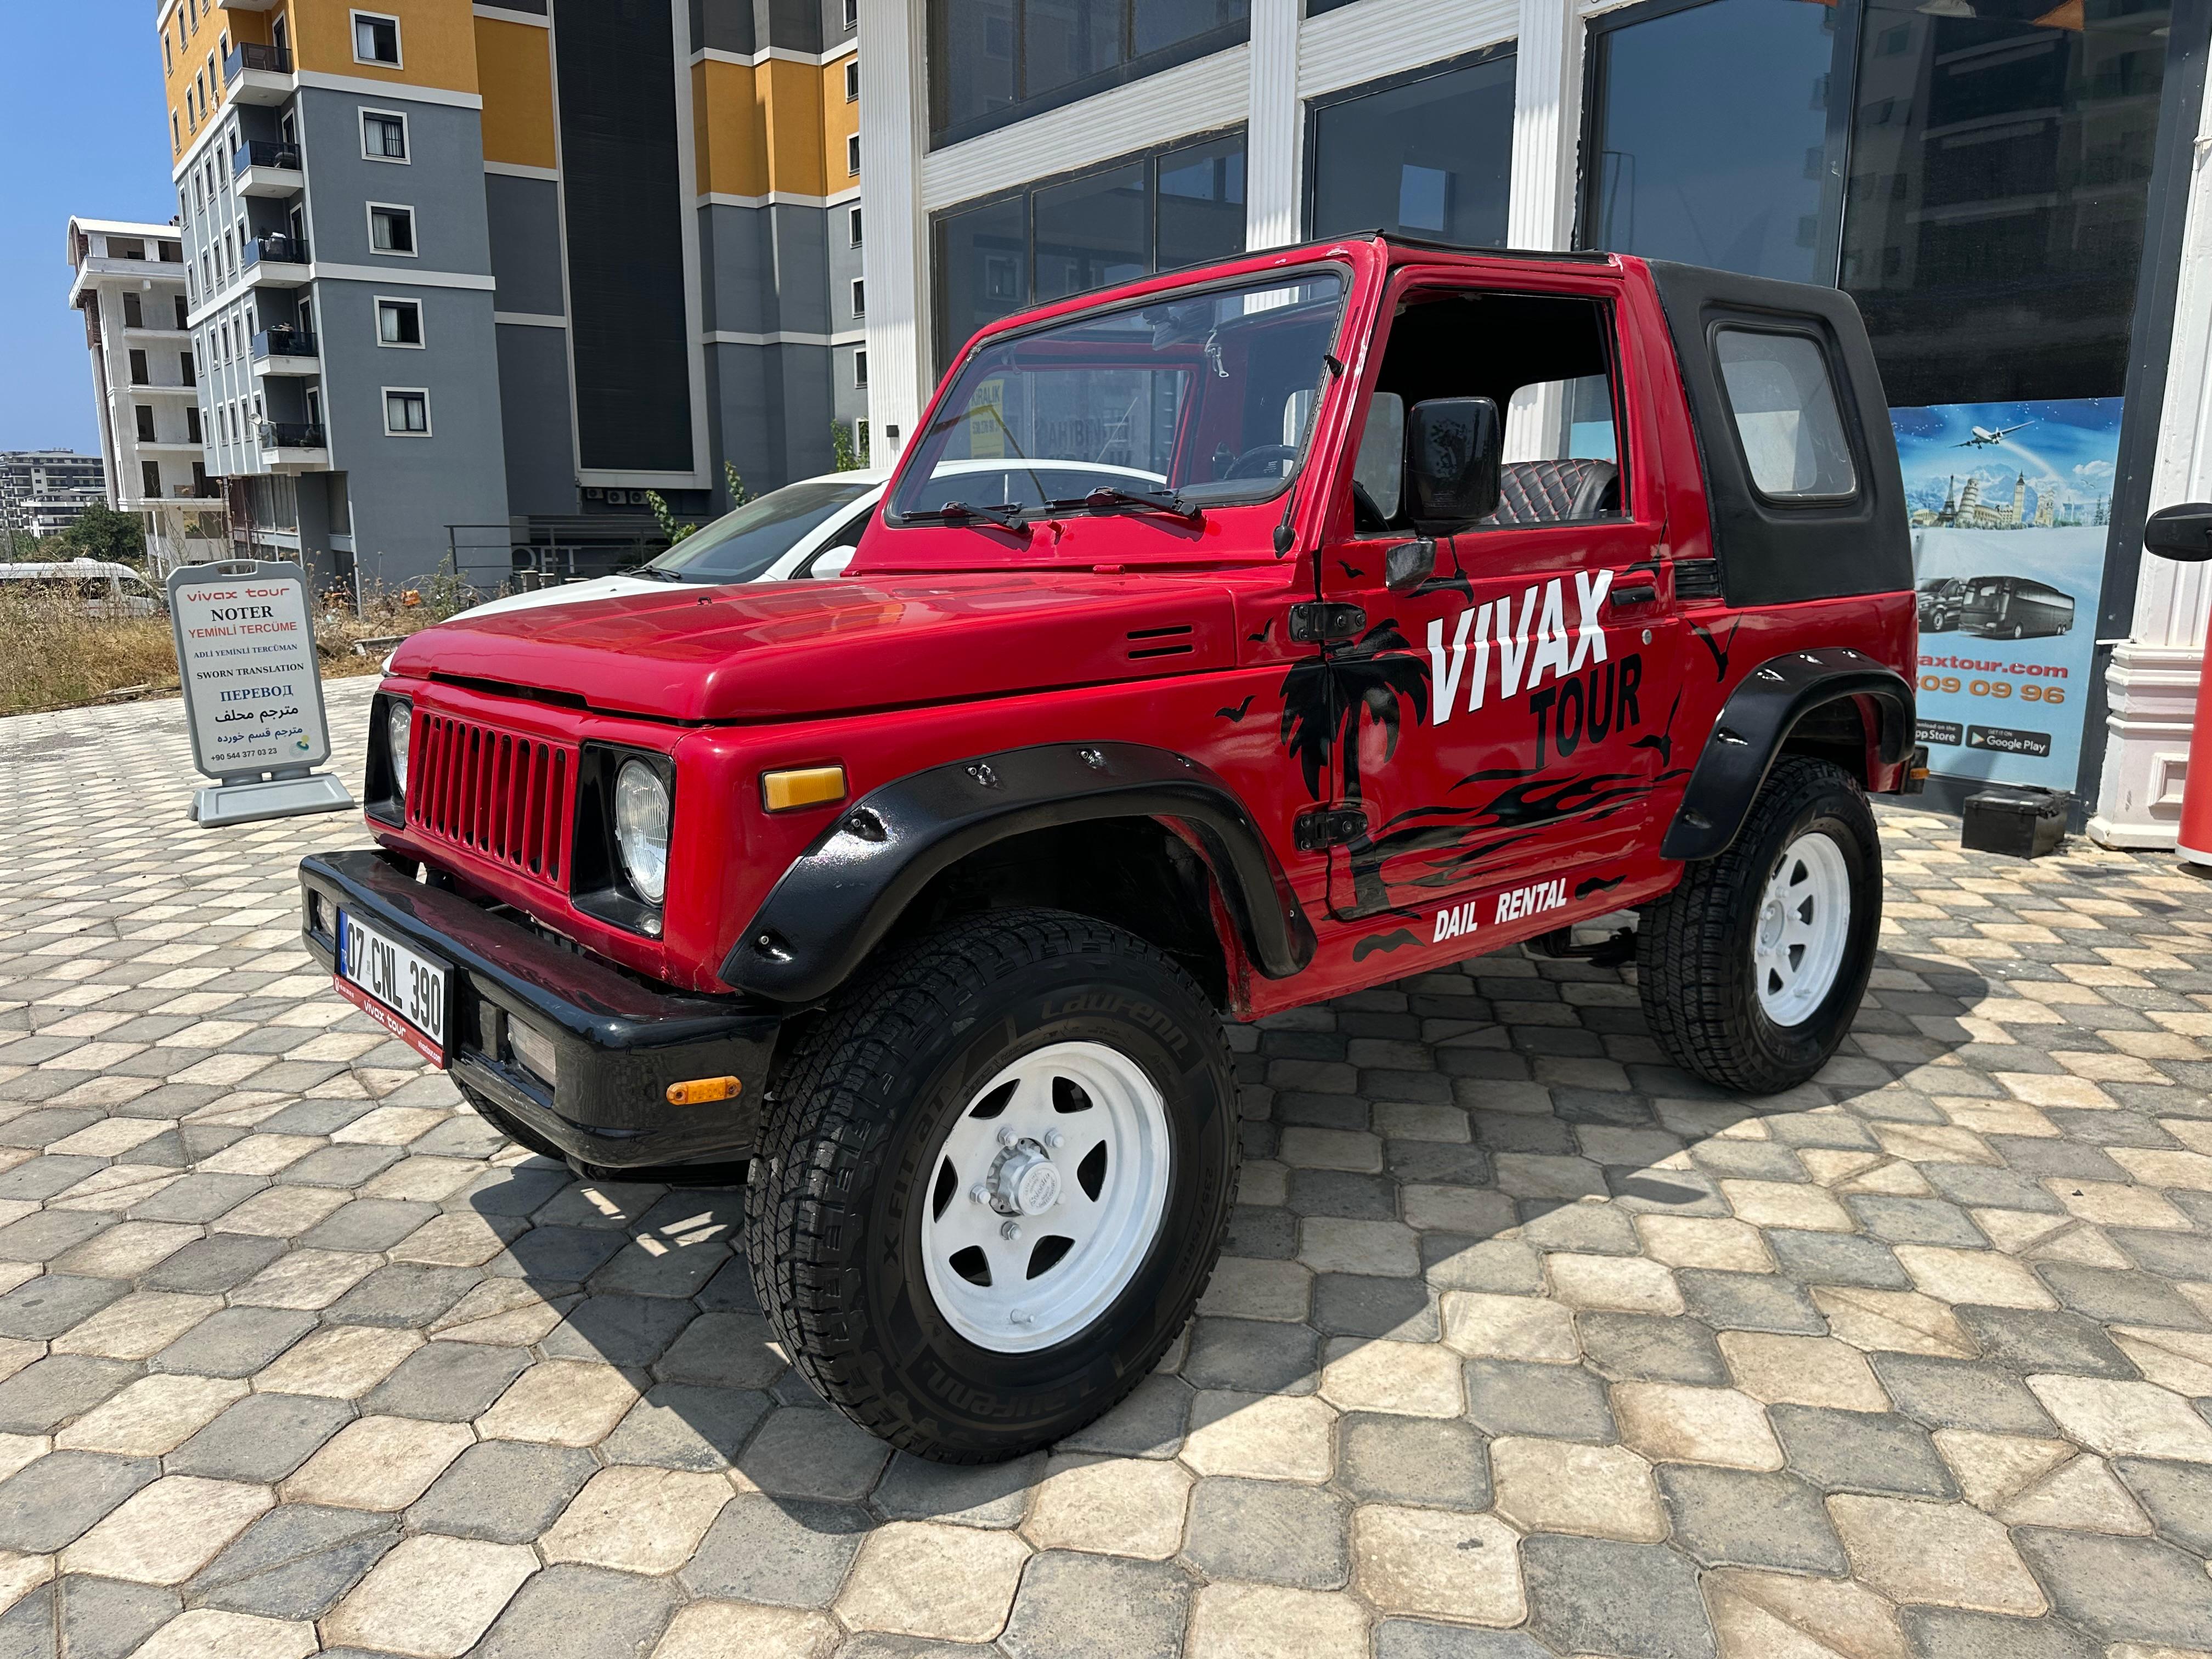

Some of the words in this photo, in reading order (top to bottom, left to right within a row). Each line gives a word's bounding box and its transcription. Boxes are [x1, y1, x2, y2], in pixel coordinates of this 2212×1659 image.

[187, 590, 238, 602] vivax
[245, 588, 290, 598] tour
[211, 606, 274, 622] NOTER
[189, 624, 236, 639] YEMİNLİ
[239, 621, 298, 635] TERCÜME
[194, 650, 213, 659] ADLİ
[252, 644, 298, 653] TERCÜMAN
[1427, 569, 1614, 727] VIVAX
[196, 669, 233, 680] SWORN
[236, 663, 304, 676] TRANSLATION
[1917, 655, 2068, 678] axtour.com
[220, 685, 294, 702] ПЕРЕВОД
[1917, 675, 1961, 693] 09
[1969, 680, 2012, 699] 09
[2020, 684, 2066, 704] 96
[215, 709, 255, 723] محلف
[259, 706, 299, 723] مترجم
[1530, 653, 1643, 768] TOUR
[217, 732, 245, 743] خورده
[249, 727, 271, 743] قسم
[275, 726, 303, 740] مترجم
[1915, 730, 1928, 740] pp
[1929, 729, 1956, 742] Store
[1987, 735, 2023, 751] Google
[2023, 740, 2046, 754] Play
[227, 752, 240, 760] 544
[1433, 901, 1478, 943] DAIL
[1494, 878, 1567, 925] RENTAL
[347, 922, 364, 981] 07
[371, 937, 403, 1009] CNL
[410, 960, 441, 1036] 390
[364, 998, 385, 1023] vivax
[387, 1014, 407, 1037] tour
